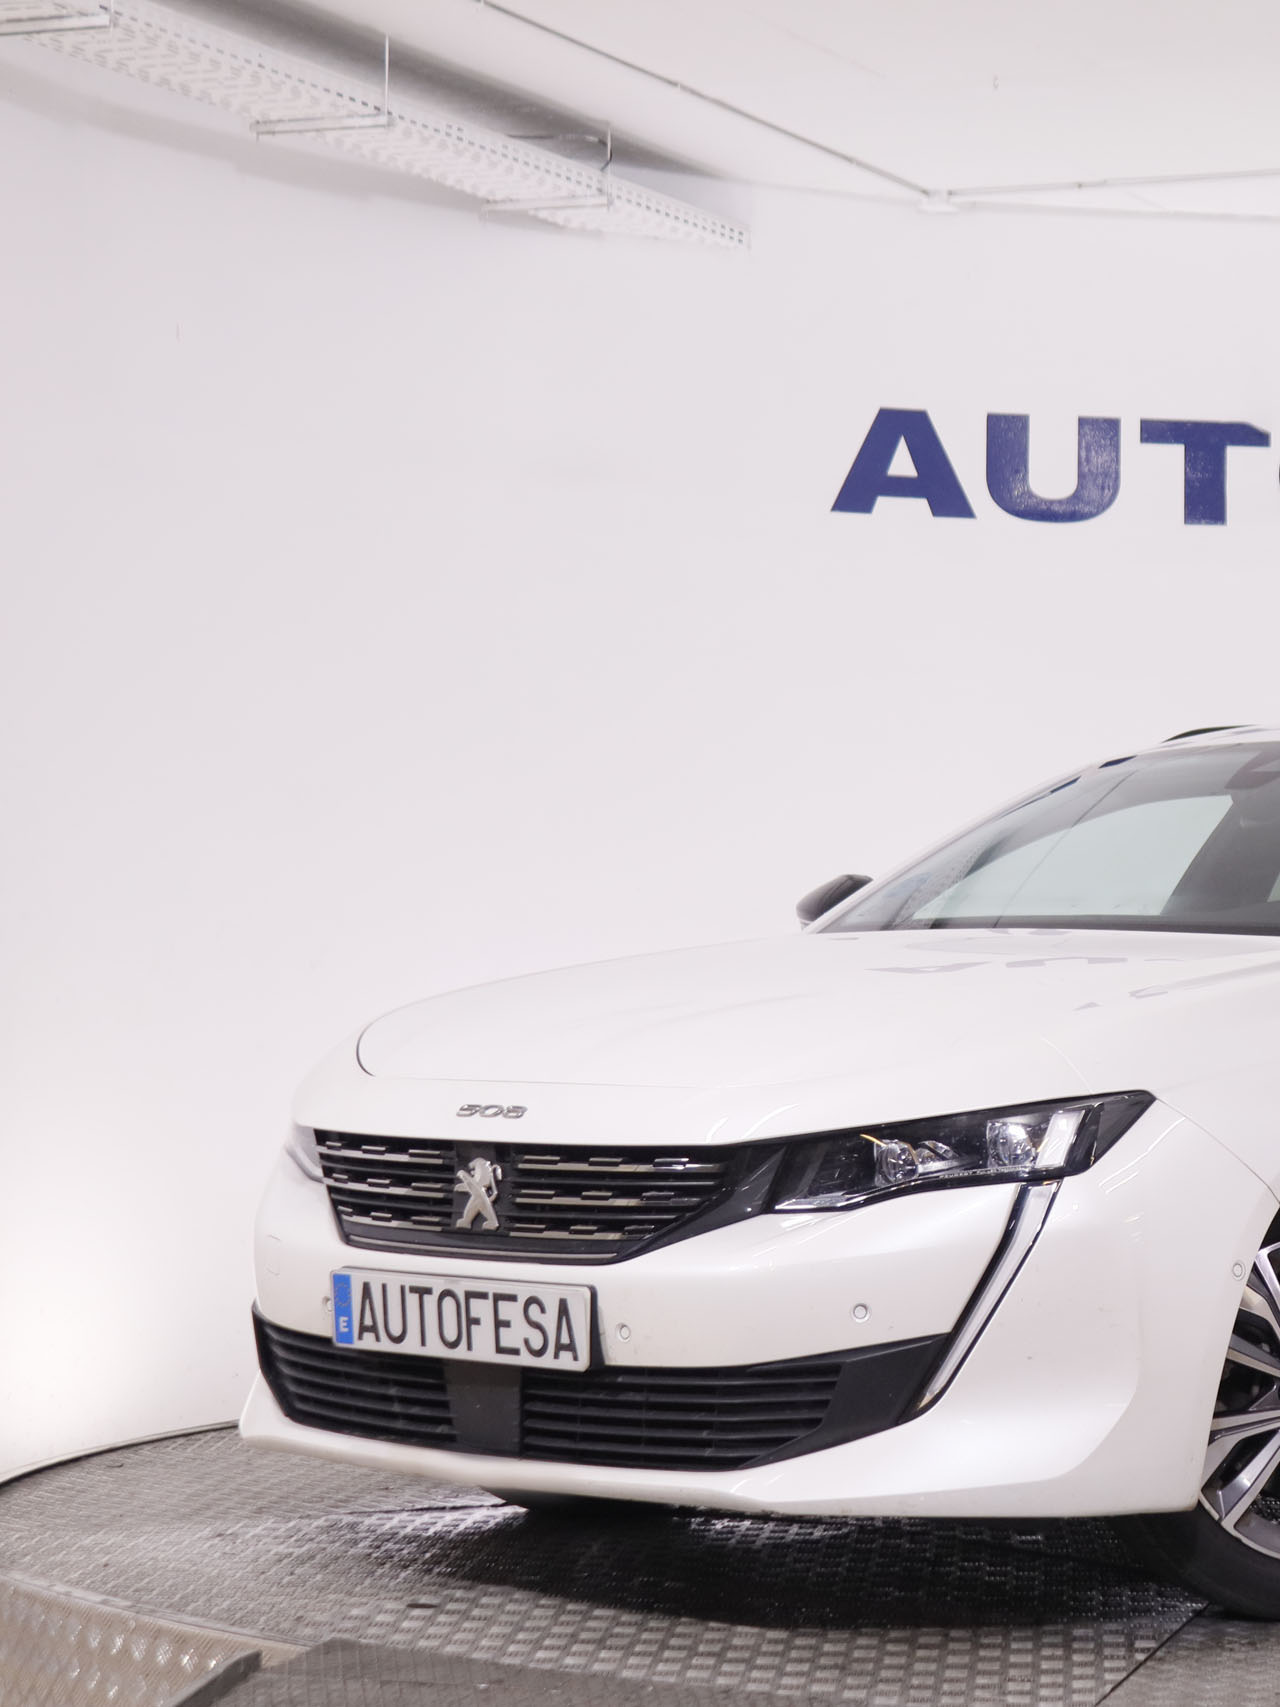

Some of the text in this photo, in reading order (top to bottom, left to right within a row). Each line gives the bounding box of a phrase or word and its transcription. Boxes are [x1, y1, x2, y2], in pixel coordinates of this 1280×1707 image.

[456, 1104, 528, 1119] 508
[338, 1316, 349, 1333] E
[357, 1281, 580, 1361] AUTOFESA
